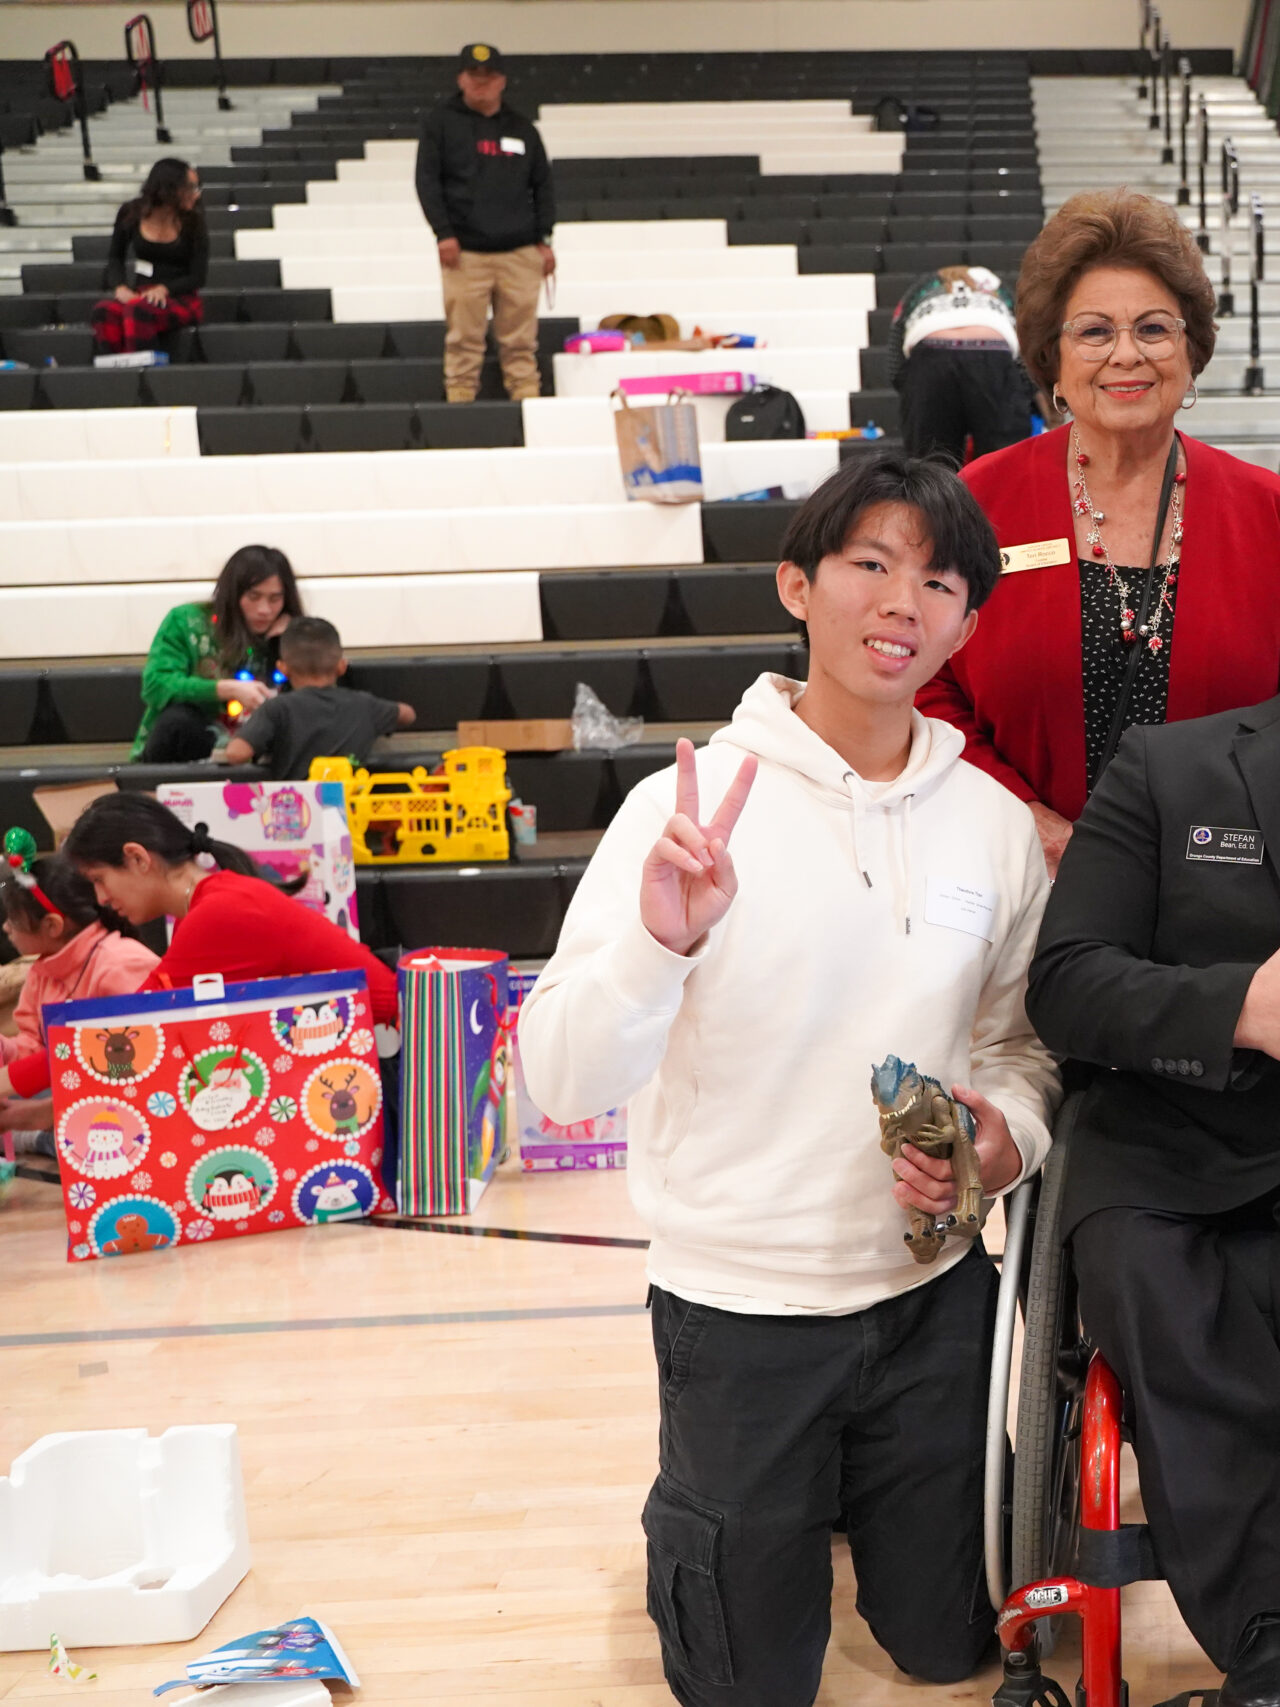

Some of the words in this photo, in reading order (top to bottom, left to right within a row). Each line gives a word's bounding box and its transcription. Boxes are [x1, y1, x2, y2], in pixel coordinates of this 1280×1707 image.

[1223, 833, 1255, 843] STEFAN
[1220, 841, 1237, 849] Bean,
[1027, 1588, 1060, 1602] OGUE
